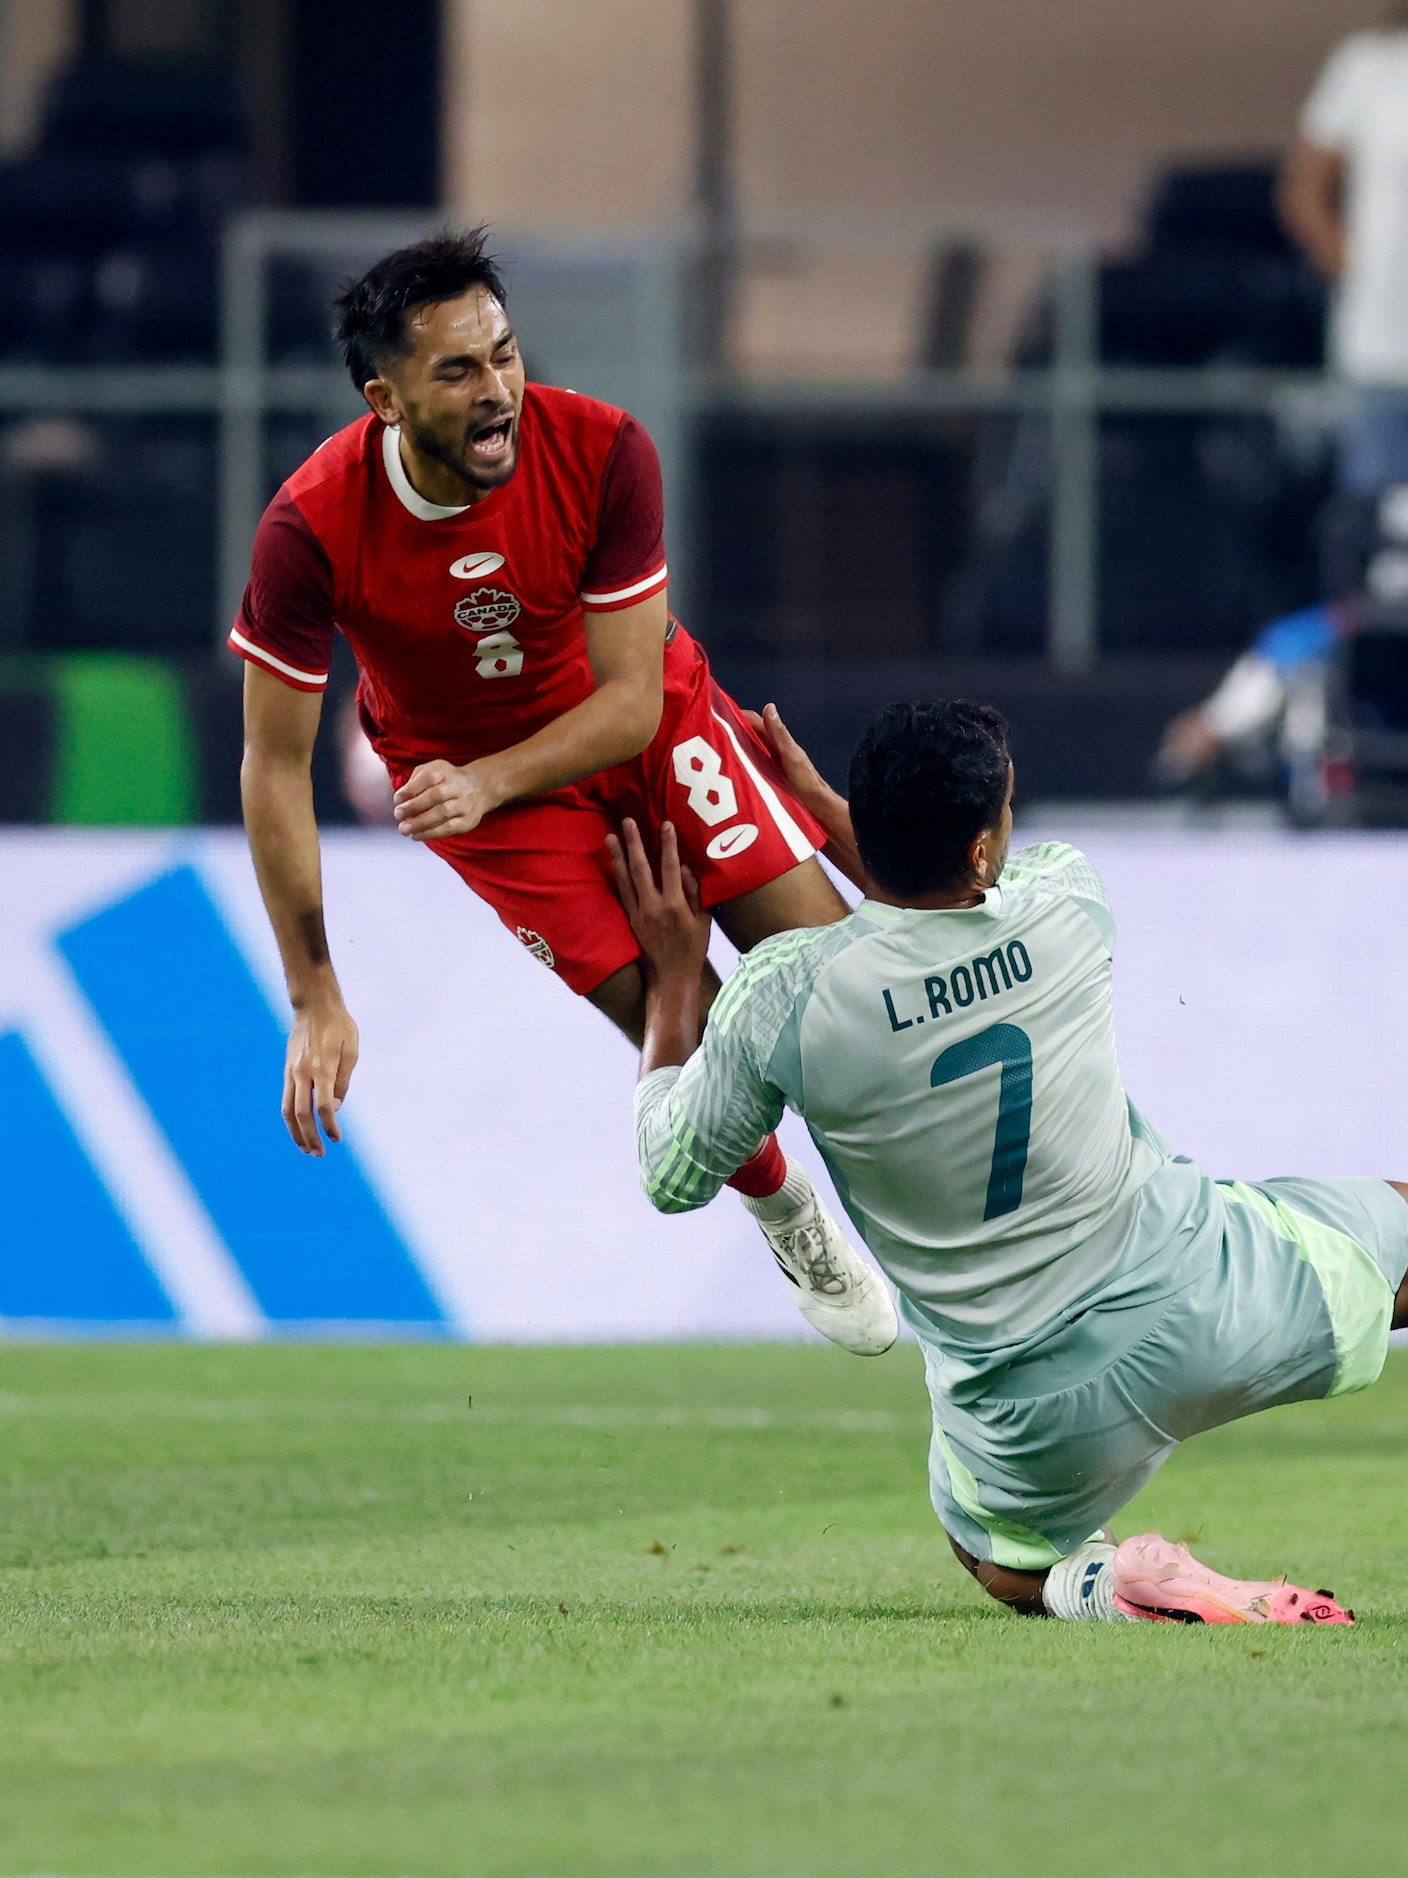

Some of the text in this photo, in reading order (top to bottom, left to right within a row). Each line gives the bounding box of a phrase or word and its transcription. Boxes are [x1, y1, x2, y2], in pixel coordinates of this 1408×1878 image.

[457, 604, 517, 620] CANADA
[472, 630, 524, 679] 8
[672, 735, 739, 827] 8
[882, 939, 1033, 1033] L.ROMO
[930, 1022, 1034, 1222] 7
